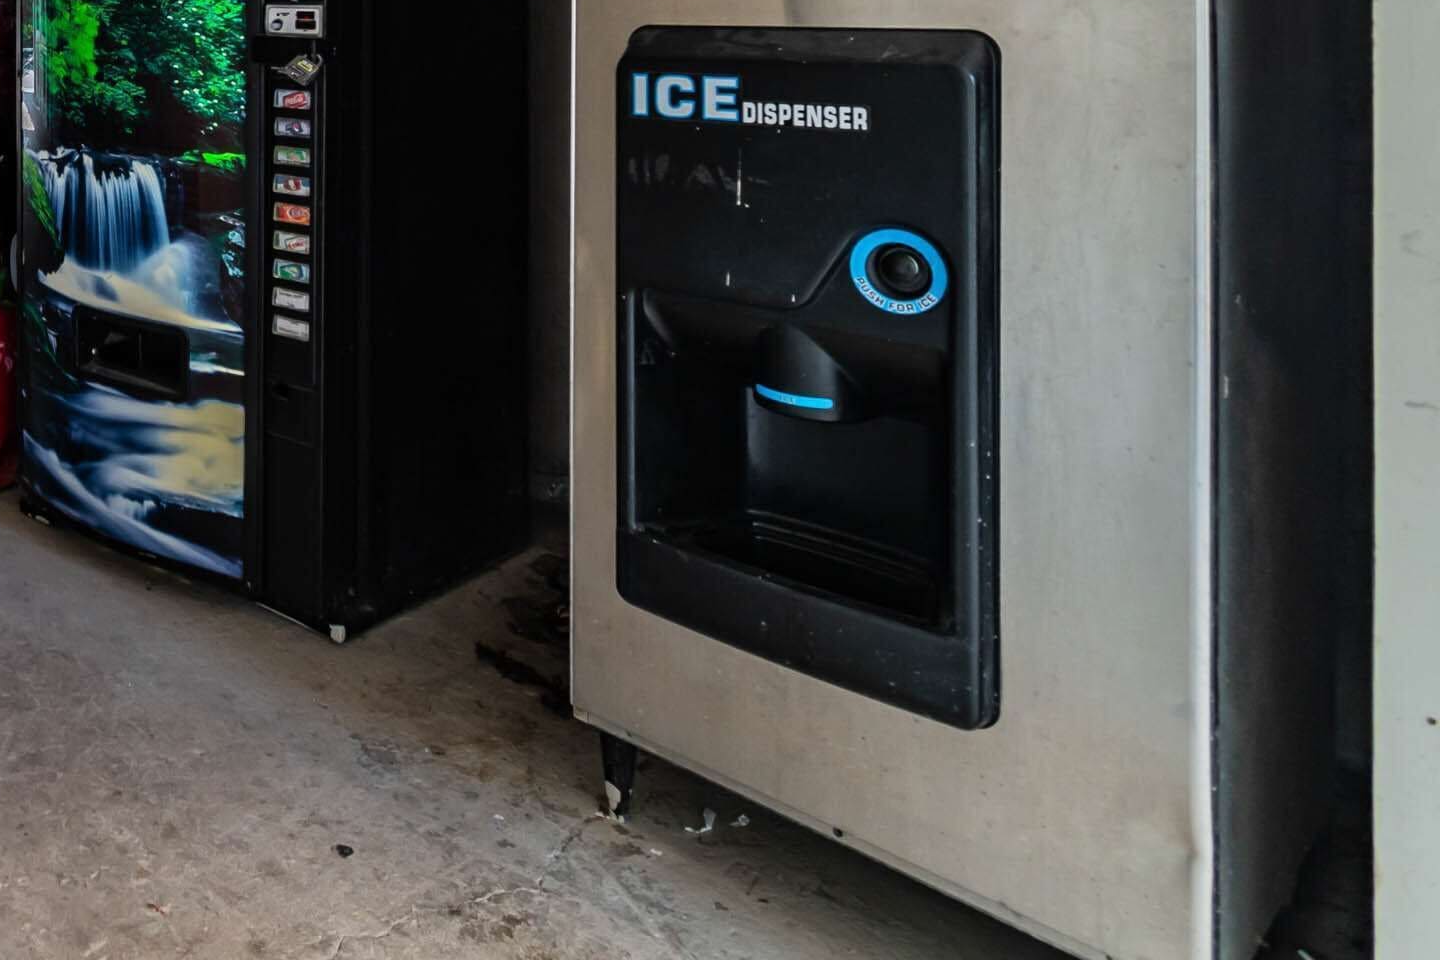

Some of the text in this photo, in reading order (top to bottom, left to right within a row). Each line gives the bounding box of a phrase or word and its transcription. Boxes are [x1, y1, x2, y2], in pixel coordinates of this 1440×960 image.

[632, 73, 869, 131] ICE DISPENSER
[857, 277, 937, 312] PUSH FOR ICE
